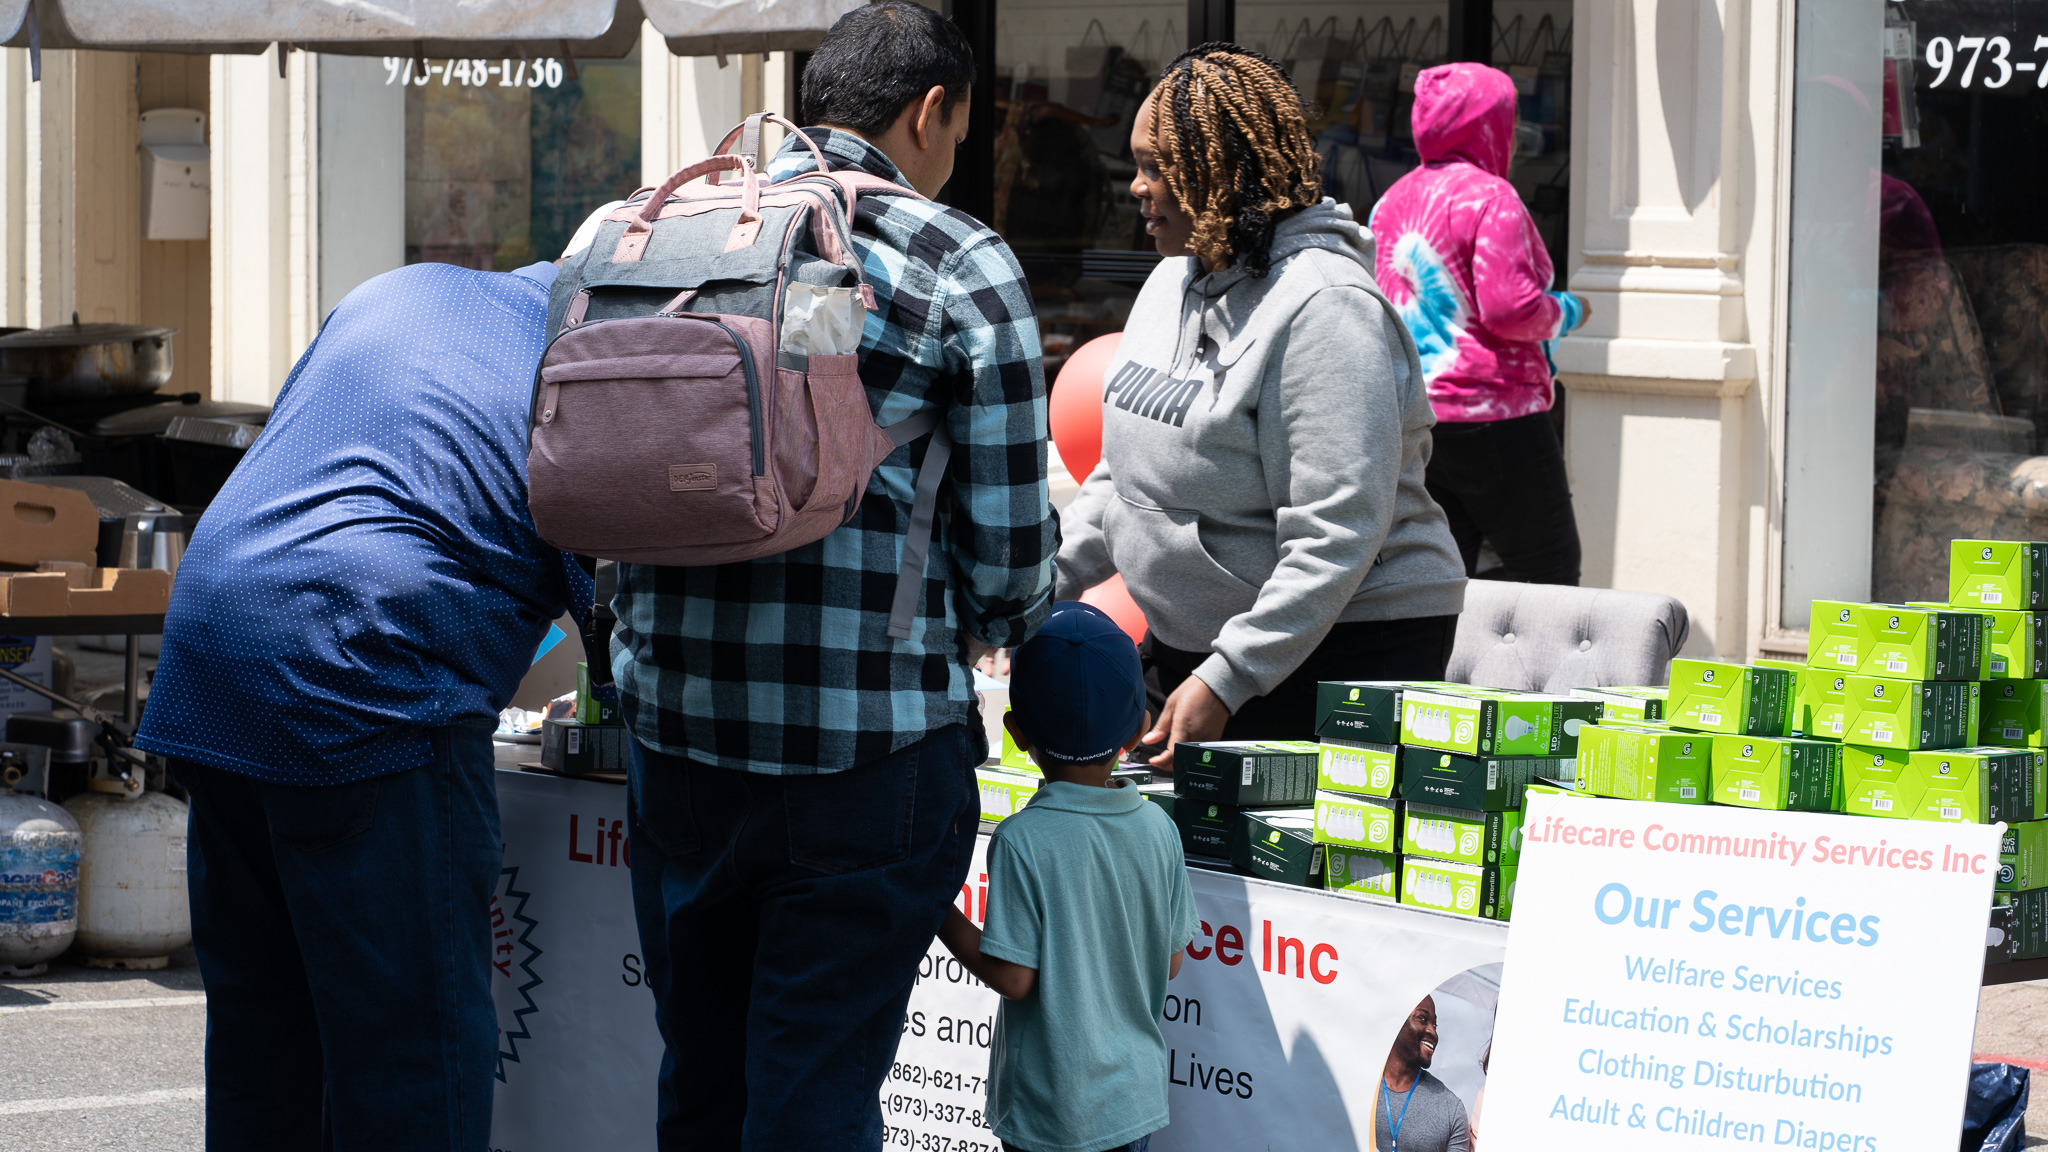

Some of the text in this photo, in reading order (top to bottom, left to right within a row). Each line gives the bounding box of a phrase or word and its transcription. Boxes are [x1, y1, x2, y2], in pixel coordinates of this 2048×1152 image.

[1104, 360, 1204, 428] PUMA
[1046, 748, 1113, 761] UNDER ARMOUR
[1550, 736, 1558, 751] LED
[1528, 816, 1987, 875] Lifecare Community Services Inc
[1594, 882, 1881, 948] Our Services
[1263, 919, 1339, 985] Inc
[1625, 955, 1843, 1000] Welfare Services
[937, 1015, 992, 1049] and
[1169, 1049, 1253, 1099] Lives
[1563, 998, 1894, 1060] Education & Scholarships
[1578, 1048, 1862, 1104] Clothing Disturbution
[1549, 1094, 1878, 1152] Adult & Children Diapers
